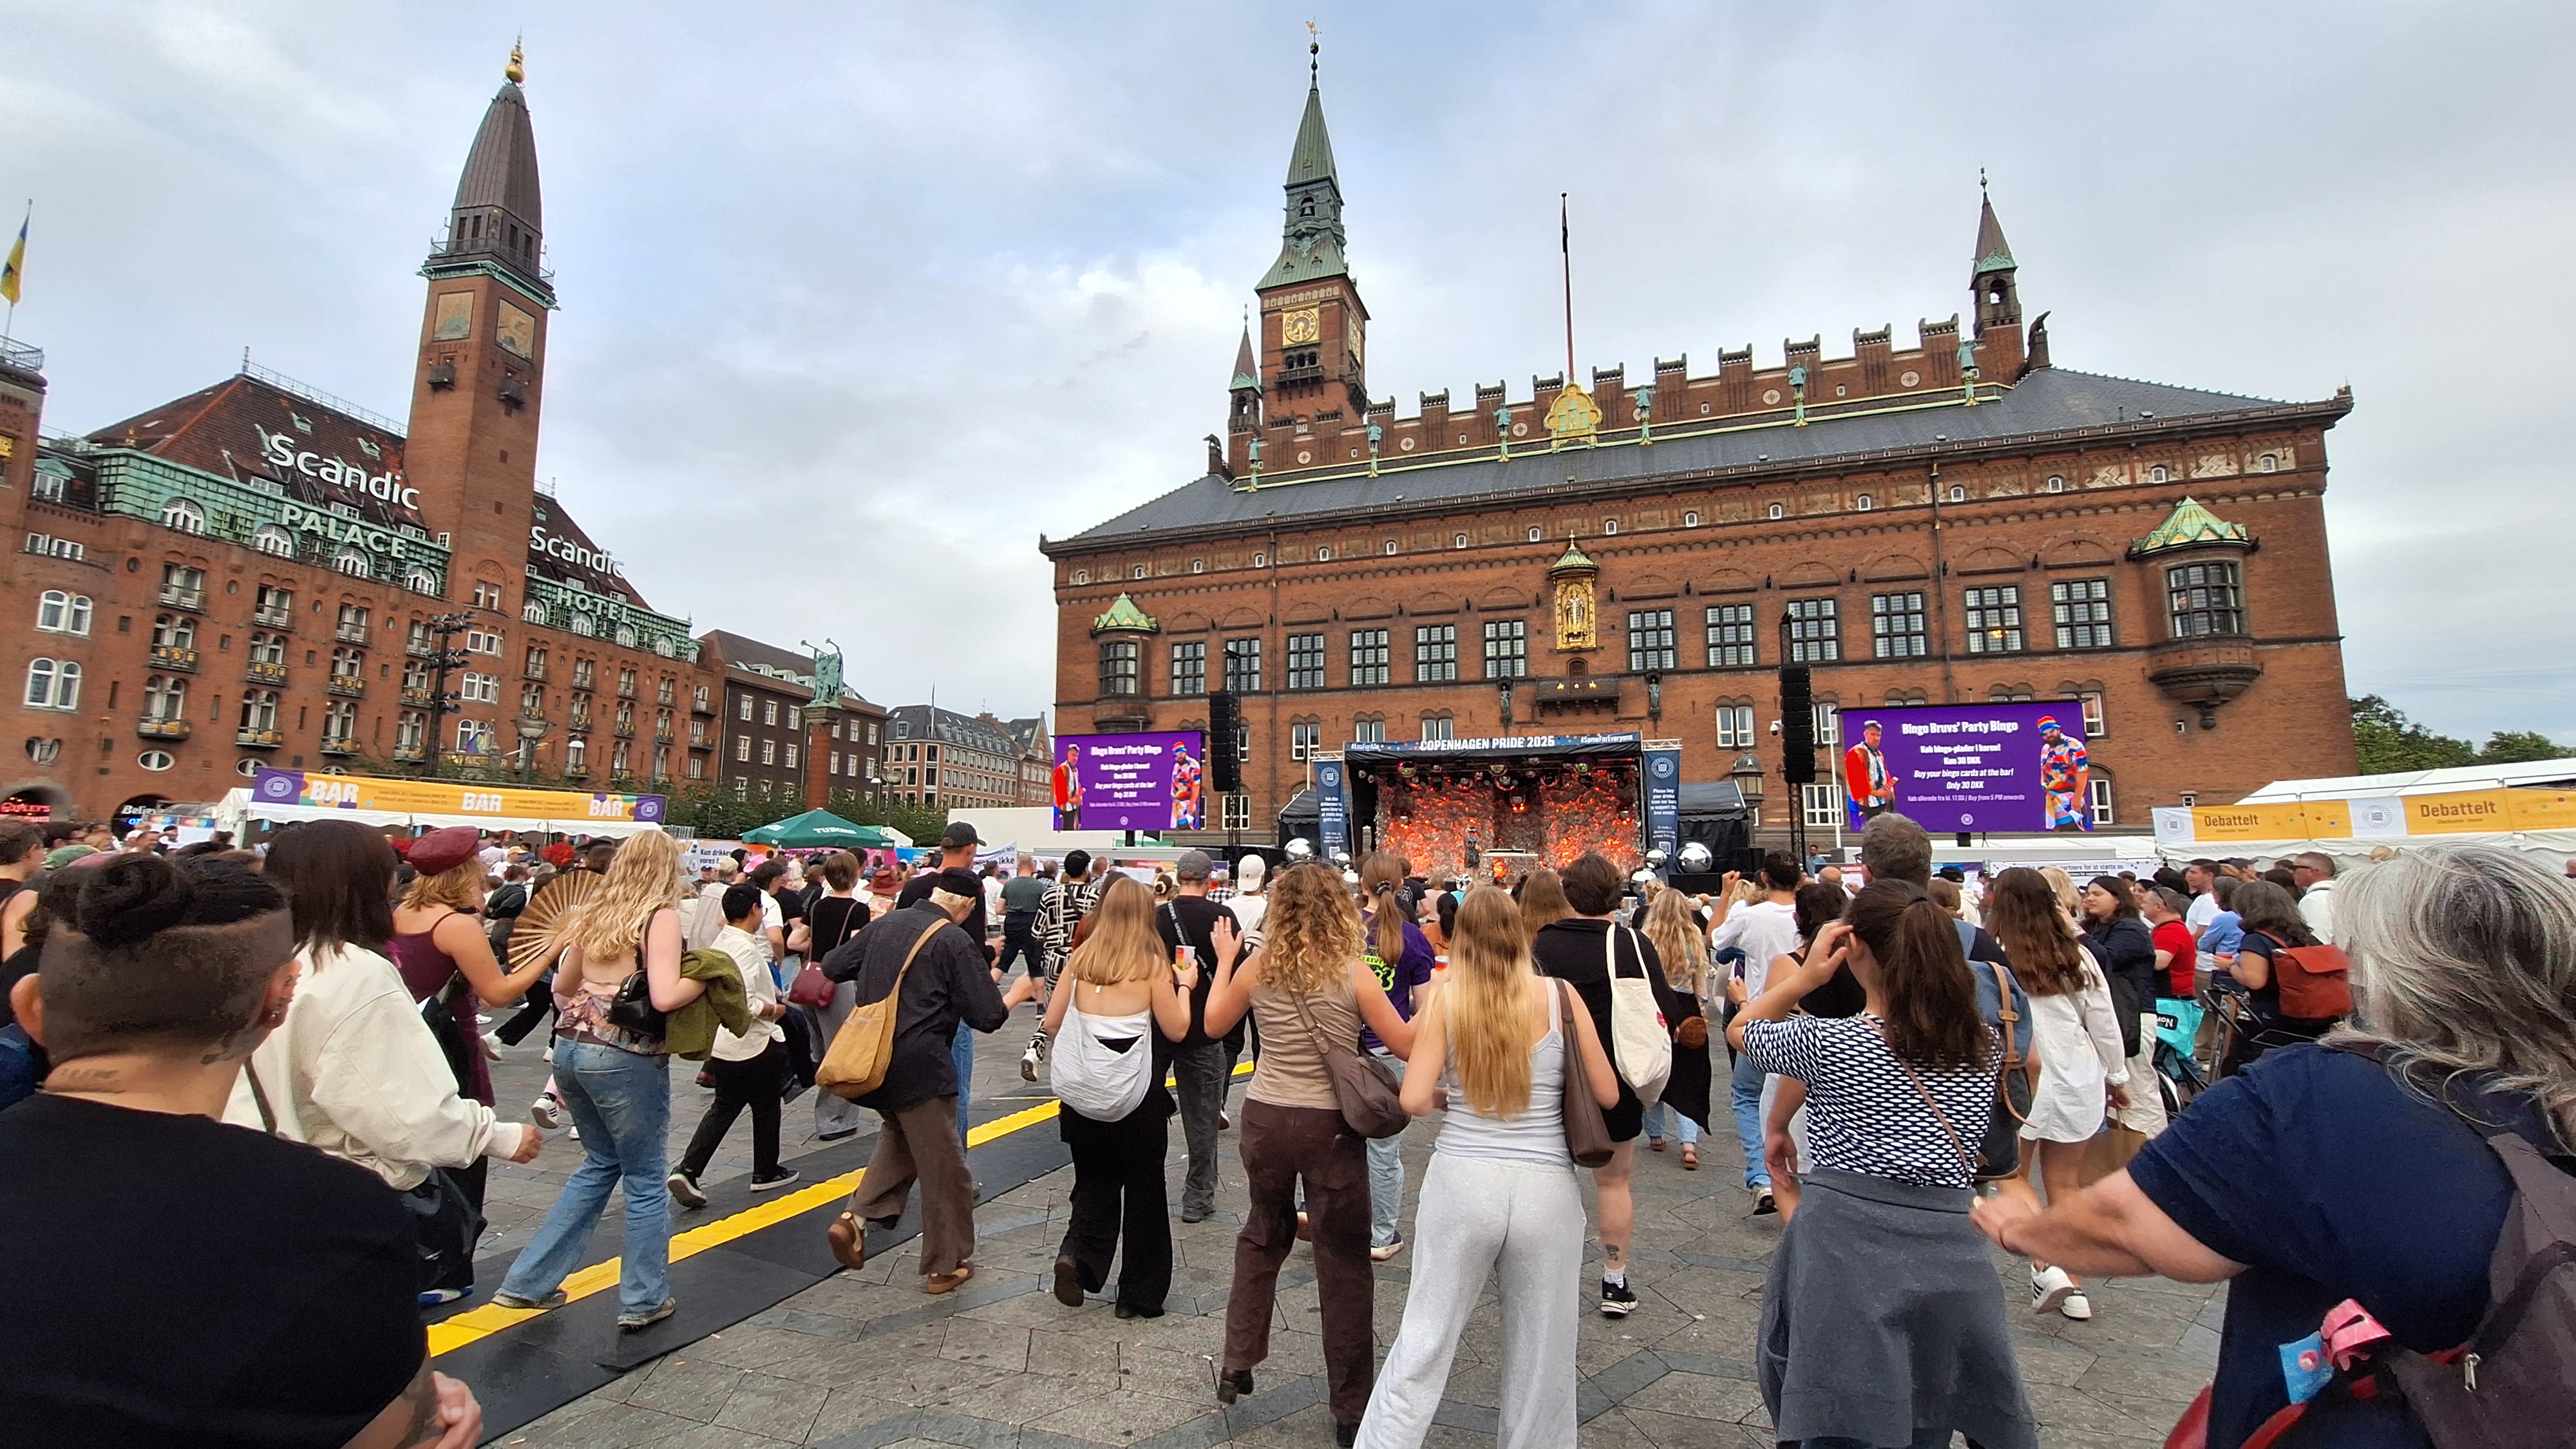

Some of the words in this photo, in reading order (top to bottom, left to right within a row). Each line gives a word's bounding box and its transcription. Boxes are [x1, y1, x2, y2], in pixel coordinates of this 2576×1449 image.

[268, 434, 420, 511] Scandic
[281, 504, 406, 559] PALACE
[530, 526, 624, 578] Scandic
[556, 587, 630, 623] HOTEL
[1902, 723, 1929, 736] Bingo
[1962, 721, 1989, 734] Party
[1989, 721, 2018, 733] Bingo
[1419, 739, 1489, 751] COPENHAGEN
[1492, 737, 1524, 749] PRIDE
[1527, 735, 1555, 748] 2025
[1580, 734, 1633, 743] #SameForEveryone
[1914, 770, 1926, 779] Buy
[1926, 771, 1941, 779] your
[1942, 770, 1960, 779] bingo
[1960, 769, 1979, 777] cards
[1987, 768, 1999, 777] the
[309, 781, 359, 803] BAR
[1946, 781, 1961, 790] Only
[1971, 781, 1984, 789] DKK
[462, 792, 503, 812] BAR
[589, 800, 623, 817] BAR
[2421, 800, 2497, 817] Debattelt
[2204, 814, 2259, 826] Debattelt
[2157, 1017, 2174, 1028] Nor
